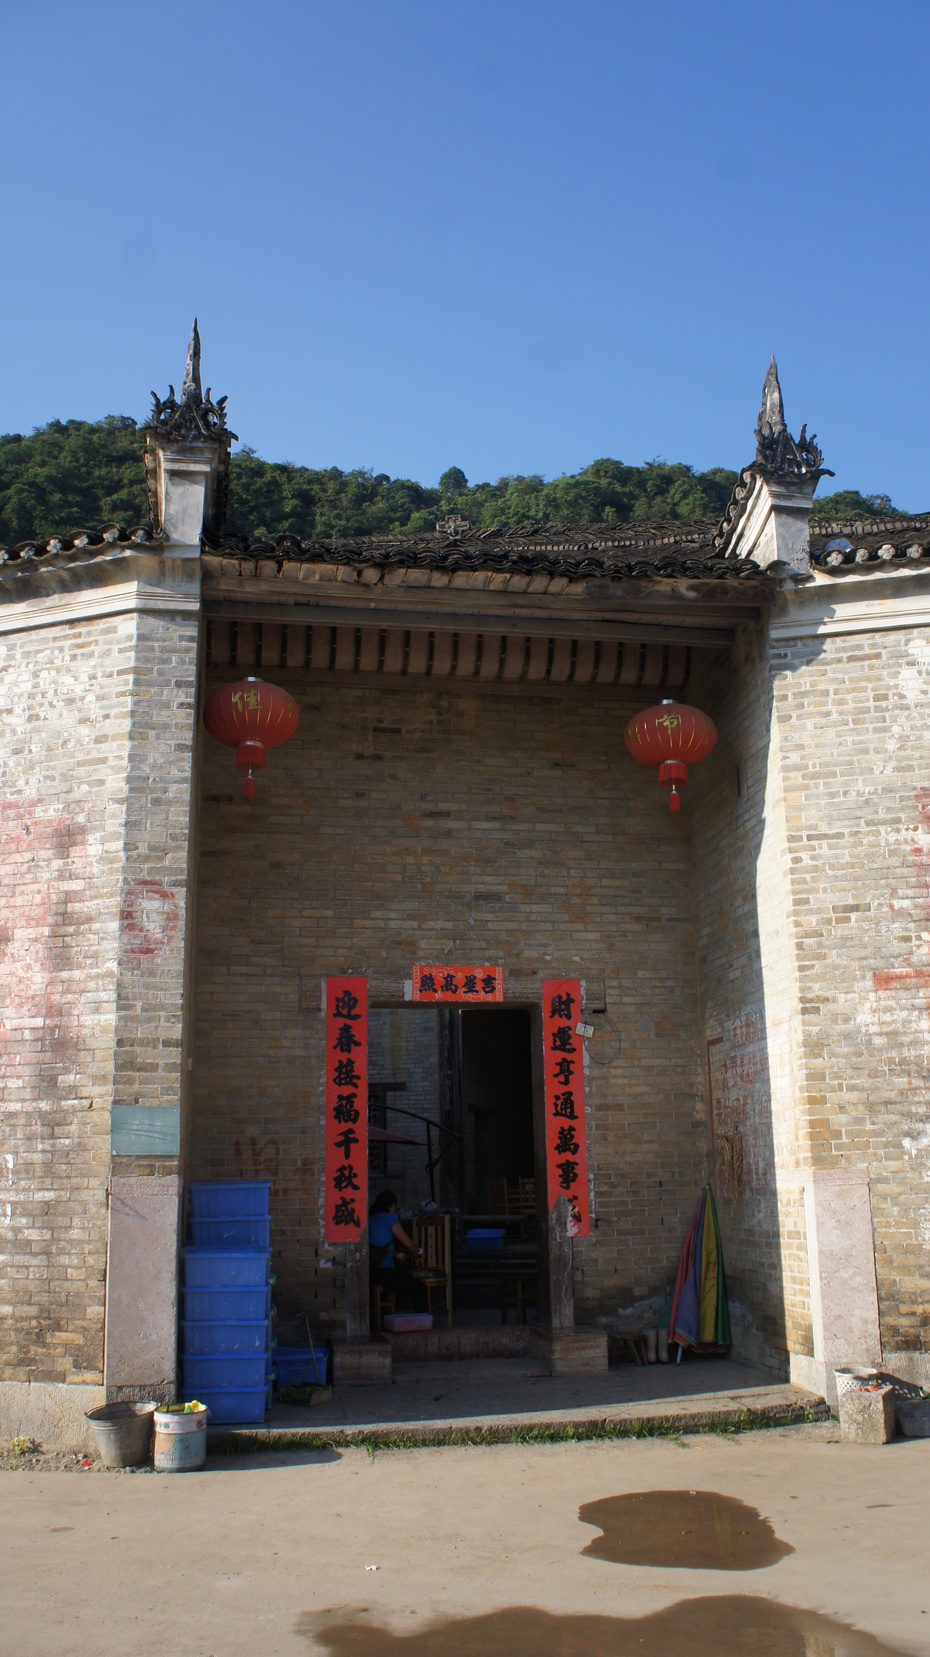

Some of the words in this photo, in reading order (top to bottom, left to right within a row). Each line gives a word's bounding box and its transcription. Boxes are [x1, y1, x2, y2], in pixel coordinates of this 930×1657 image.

[232, 688, 263, 712] 佳
[332, 989, 362, 1229] 迎春接福千秋盛
